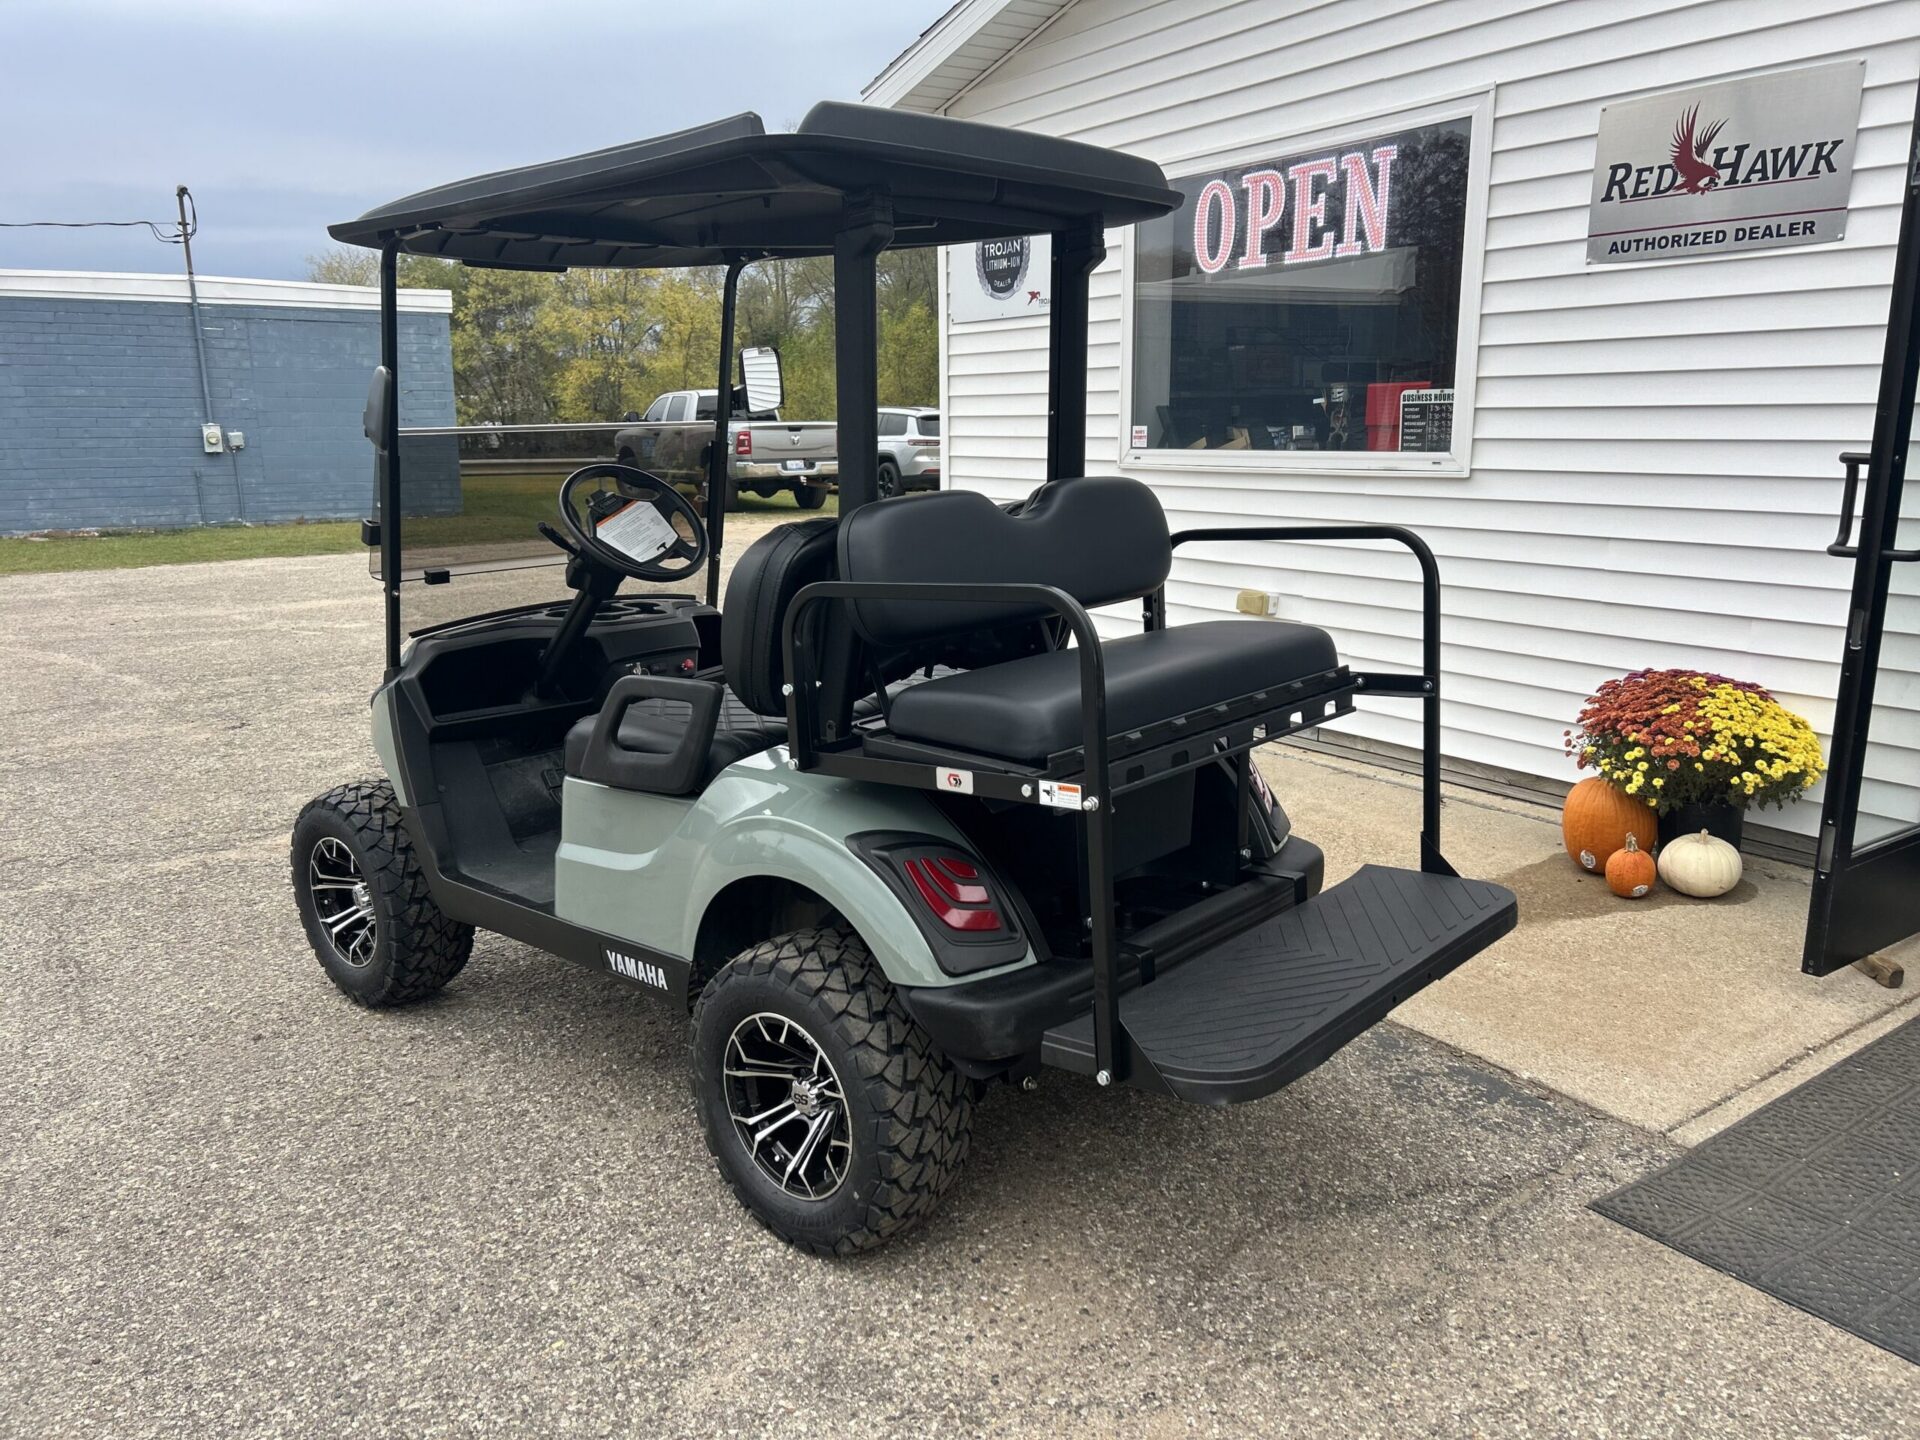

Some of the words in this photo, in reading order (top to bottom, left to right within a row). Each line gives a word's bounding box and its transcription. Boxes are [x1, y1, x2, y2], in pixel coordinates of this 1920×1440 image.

[1600, 162, 1678, 203] RED
[1706, 139, 1844, 188] HAWK
[1193, 145, 1398, 274] OPEN
[1608, 229, 1728, 255] AUTHORIZED
[1734, 220, 1816, 243] DEALER
[984, 239, 1021, 258] TROJAN
[985, 256, 1021, 272] LITHIUM-ION
[993, 277, 1012, 288] DEALER
[1402, 393, 1433, 402] BUSINESS
[1433, 393, 1454, 402] HOURS
[606, 949, 669, 991] YAMAHA
[793, 1093, 809, 1105] SS
